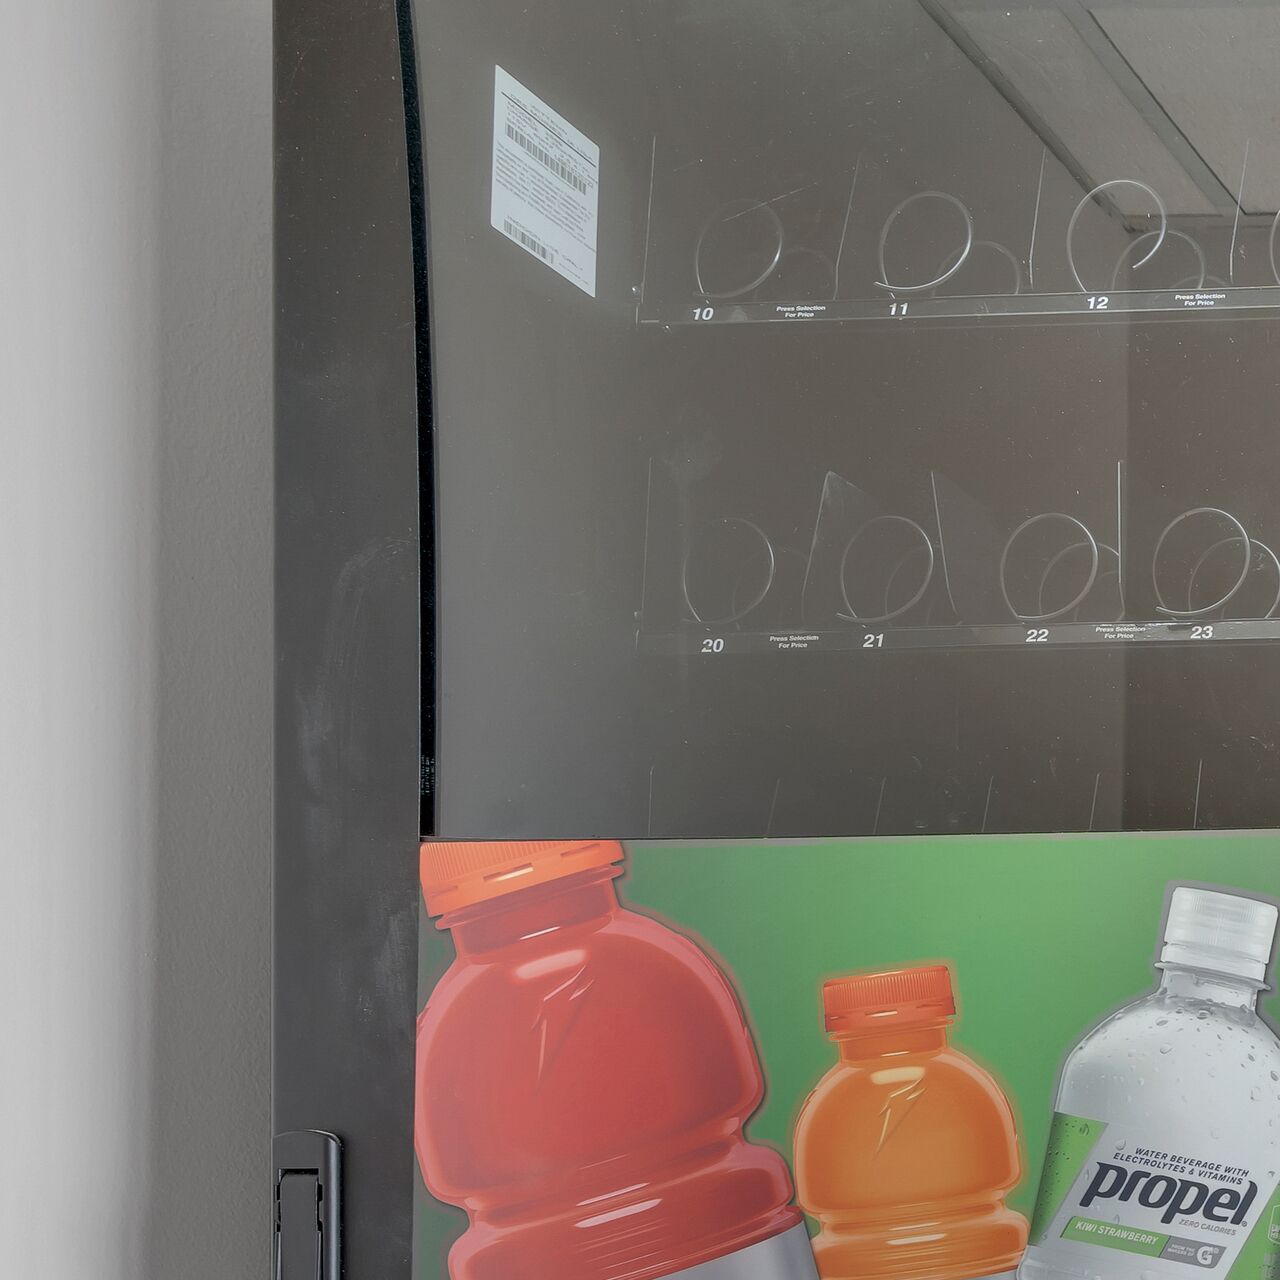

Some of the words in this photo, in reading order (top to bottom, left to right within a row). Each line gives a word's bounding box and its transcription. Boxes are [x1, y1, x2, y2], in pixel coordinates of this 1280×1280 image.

[888, 303, 908, 316] 11
[1087, 296, 1109, 310] 12
[692, 307, 714, 321] 10
[1025, 629, 1049, 643] 22
[1190, 625, 1214, 639] 23
[701, 638, 724, 653] 20
[862, 633, 885, 648] 21
[1113, 1152, 1186, 1174] ELECTROLYTES
[1197, 1169, 1244, 1186] VITAMINS
[1135, 1147, 1168, 1161] WATER
[1170, 1154, 1222, 1172] BEVERAGE
[1224, 1165, 1250, 1177] WITH
[1079, 1161, 1258, 1225] propel
[1074, 1220, 1097, 1233] KIWI
[1097, 1225, 1160, 1245] STRAWBERRY
[1200, 1222, 1237, 1236] CALORIES
